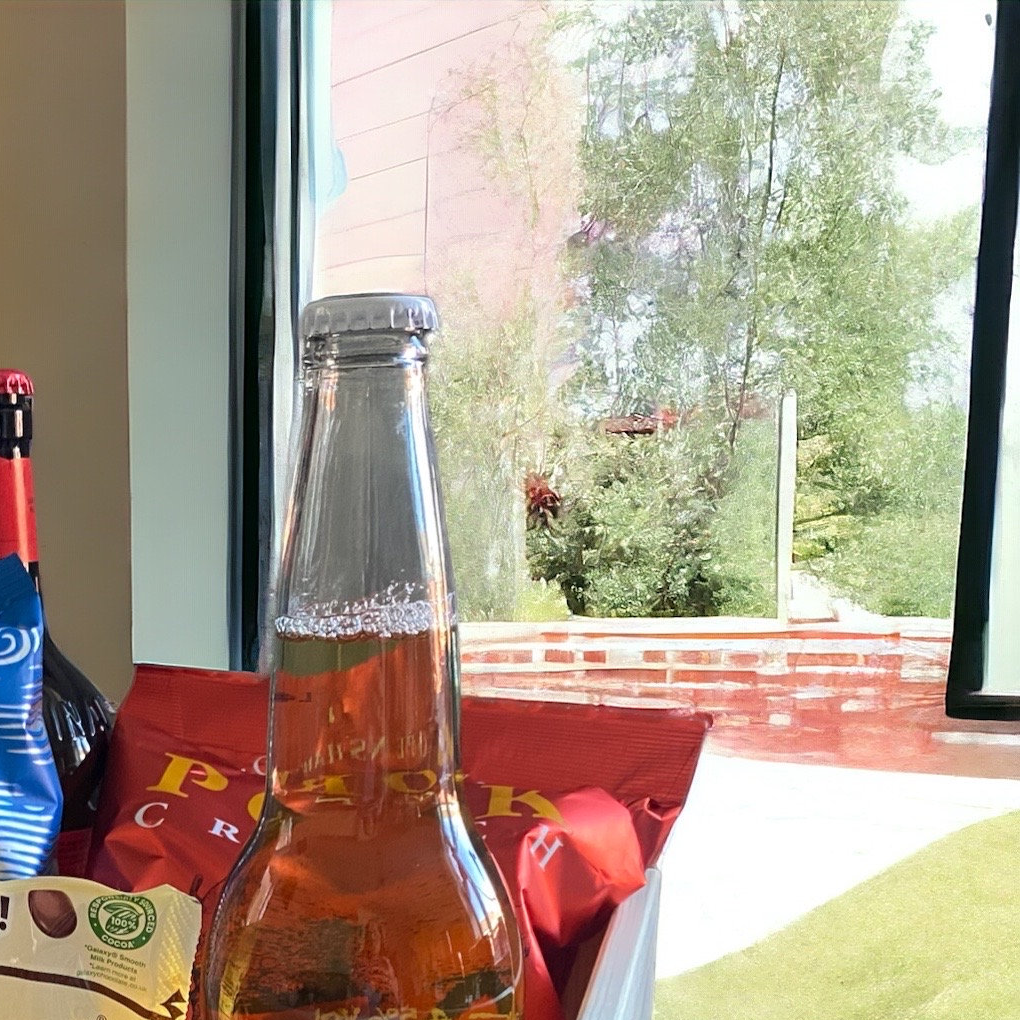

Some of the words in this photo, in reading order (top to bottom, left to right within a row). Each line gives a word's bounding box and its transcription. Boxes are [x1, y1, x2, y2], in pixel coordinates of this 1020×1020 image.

[111, 916, 137, 930] 100%
[101, 934, 135, 949] COCOA
[90, 953, 105, 964] Milk
[106, 957, 138, 975] Products
[119, 952, 146, 969] Smooth
